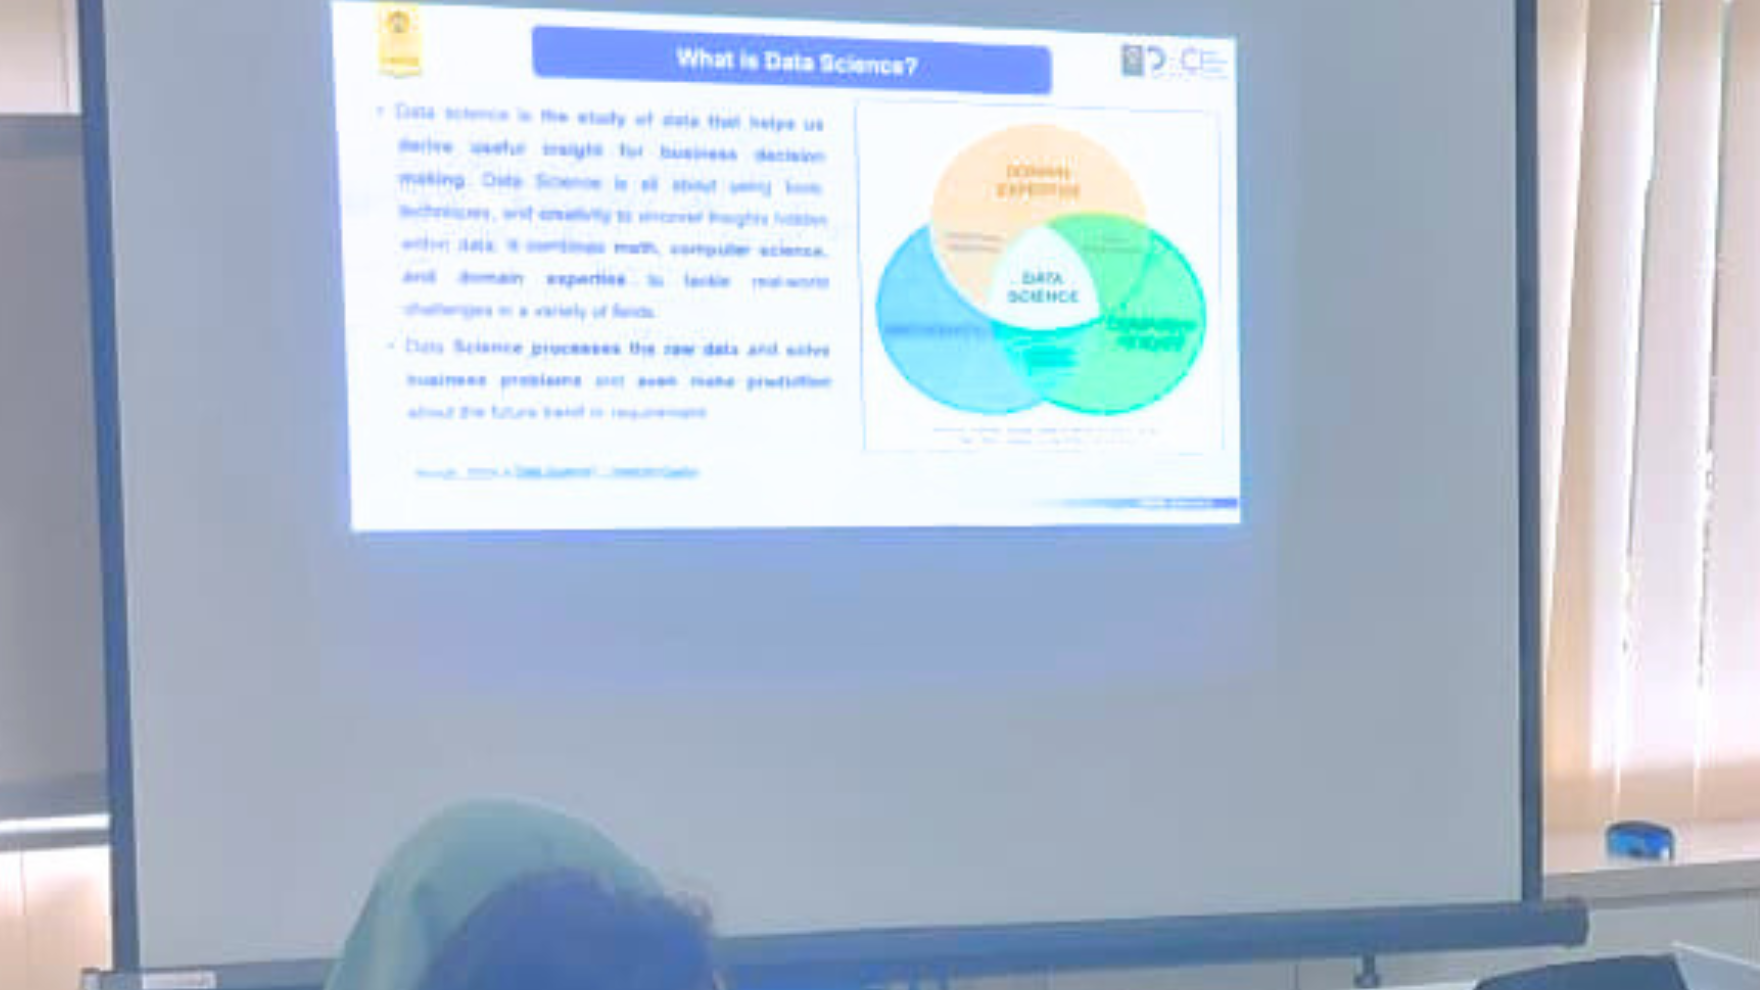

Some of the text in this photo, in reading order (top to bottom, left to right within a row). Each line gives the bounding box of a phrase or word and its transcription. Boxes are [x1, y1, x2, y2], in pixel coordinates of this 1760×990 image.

[676, 47, 920, 77] What is Data Science?
[541, 106, 569, 123] the
[577, 108, 627, 128] study
[635, 108, 655, 128] of
[662, 109, 701, 128] data
[708, 109, 741, 129] that
[804, 115, 824, 131] us
[1021, 270, 1067, 287] DATA
[1006, 289, 1081, 305] SCIENCE
